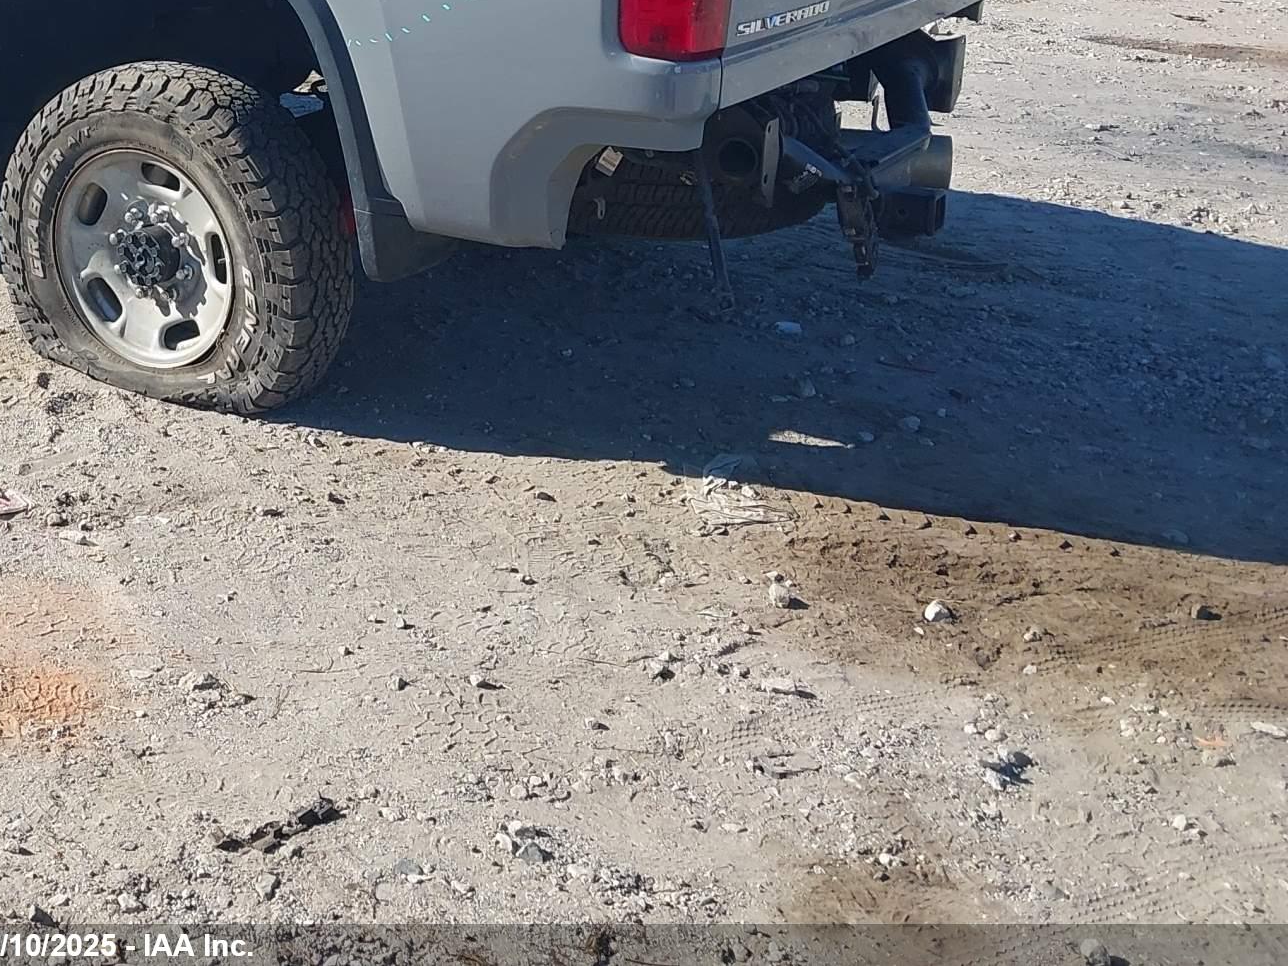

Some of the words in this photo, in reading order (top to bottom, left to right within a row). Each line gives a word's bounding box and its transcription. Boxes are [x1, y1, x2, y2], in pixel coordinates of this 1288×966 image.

[736, 0, 831, 36] SILVERADO
[27, 149, 64, 278] GRABBER
[197, 265, 259, 384] GENERAL
